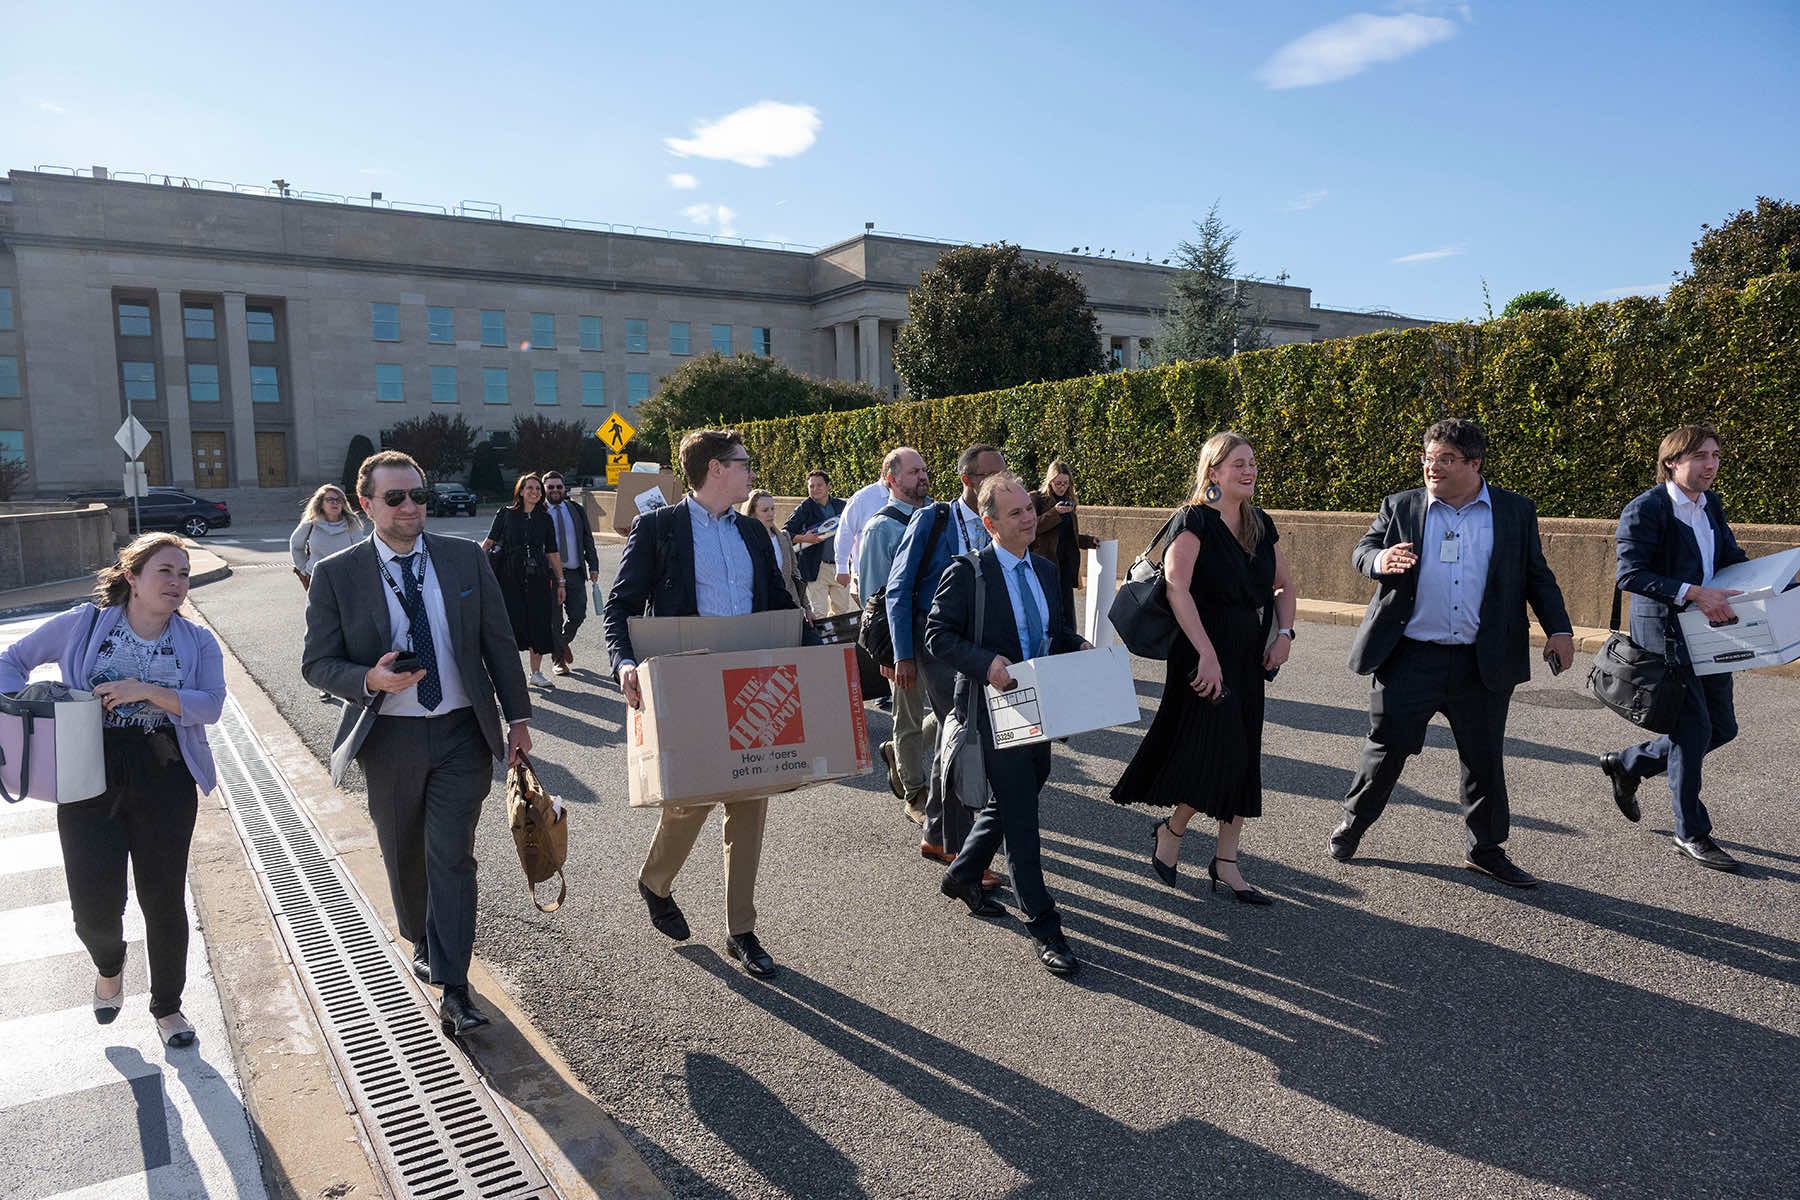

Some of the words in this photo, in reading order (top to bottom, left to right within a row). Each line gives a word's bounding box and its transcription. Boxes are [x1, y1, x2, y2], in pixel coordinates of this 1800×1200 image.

[729, 665, 798, 749] HOME
[732, 676, 763, 708] THE
[758, 693, 801, 746] DEPOT
[732, 766, 750, 779] get
